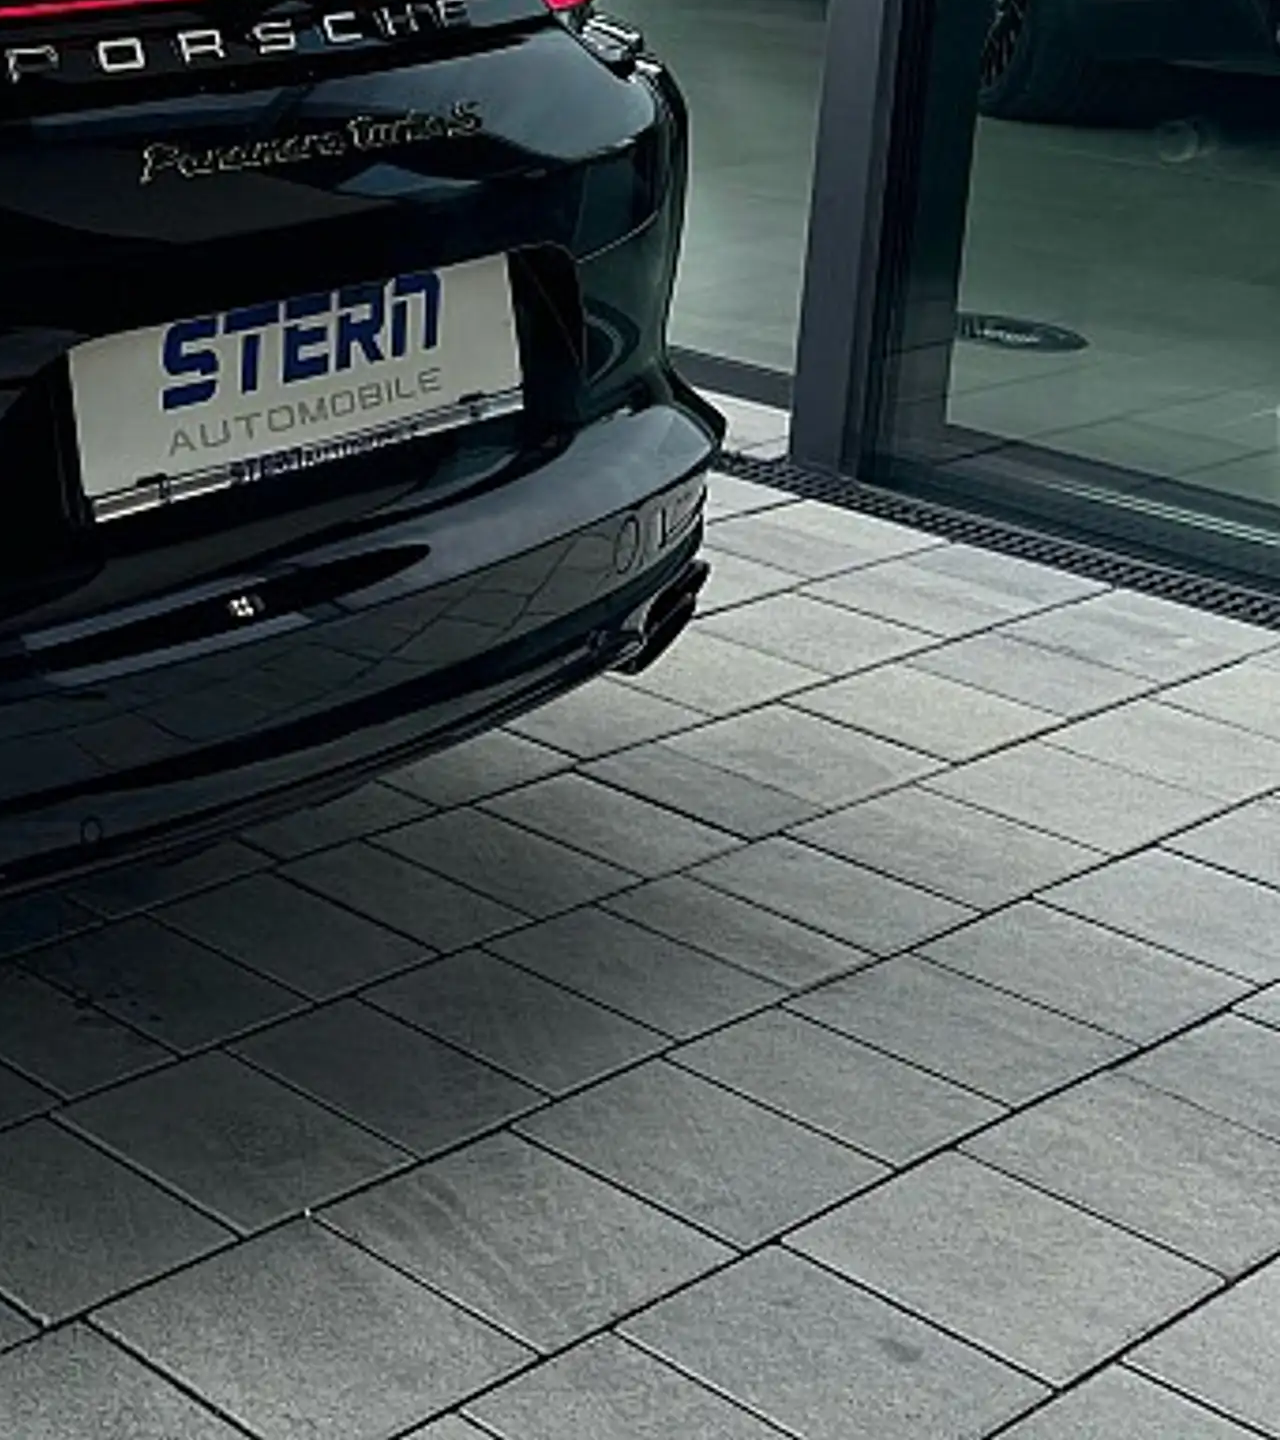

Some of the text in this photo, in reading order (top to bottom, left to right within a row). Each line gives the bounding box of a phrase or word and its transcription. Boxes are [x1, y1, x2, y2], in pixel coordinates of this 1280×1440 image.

[139, 131, 346, 185] Panamera
[447, 101, 482, 138] S
[162, 271, 441, 411] STERN
[168, 367, 441, 456] AUTOMOBILE
